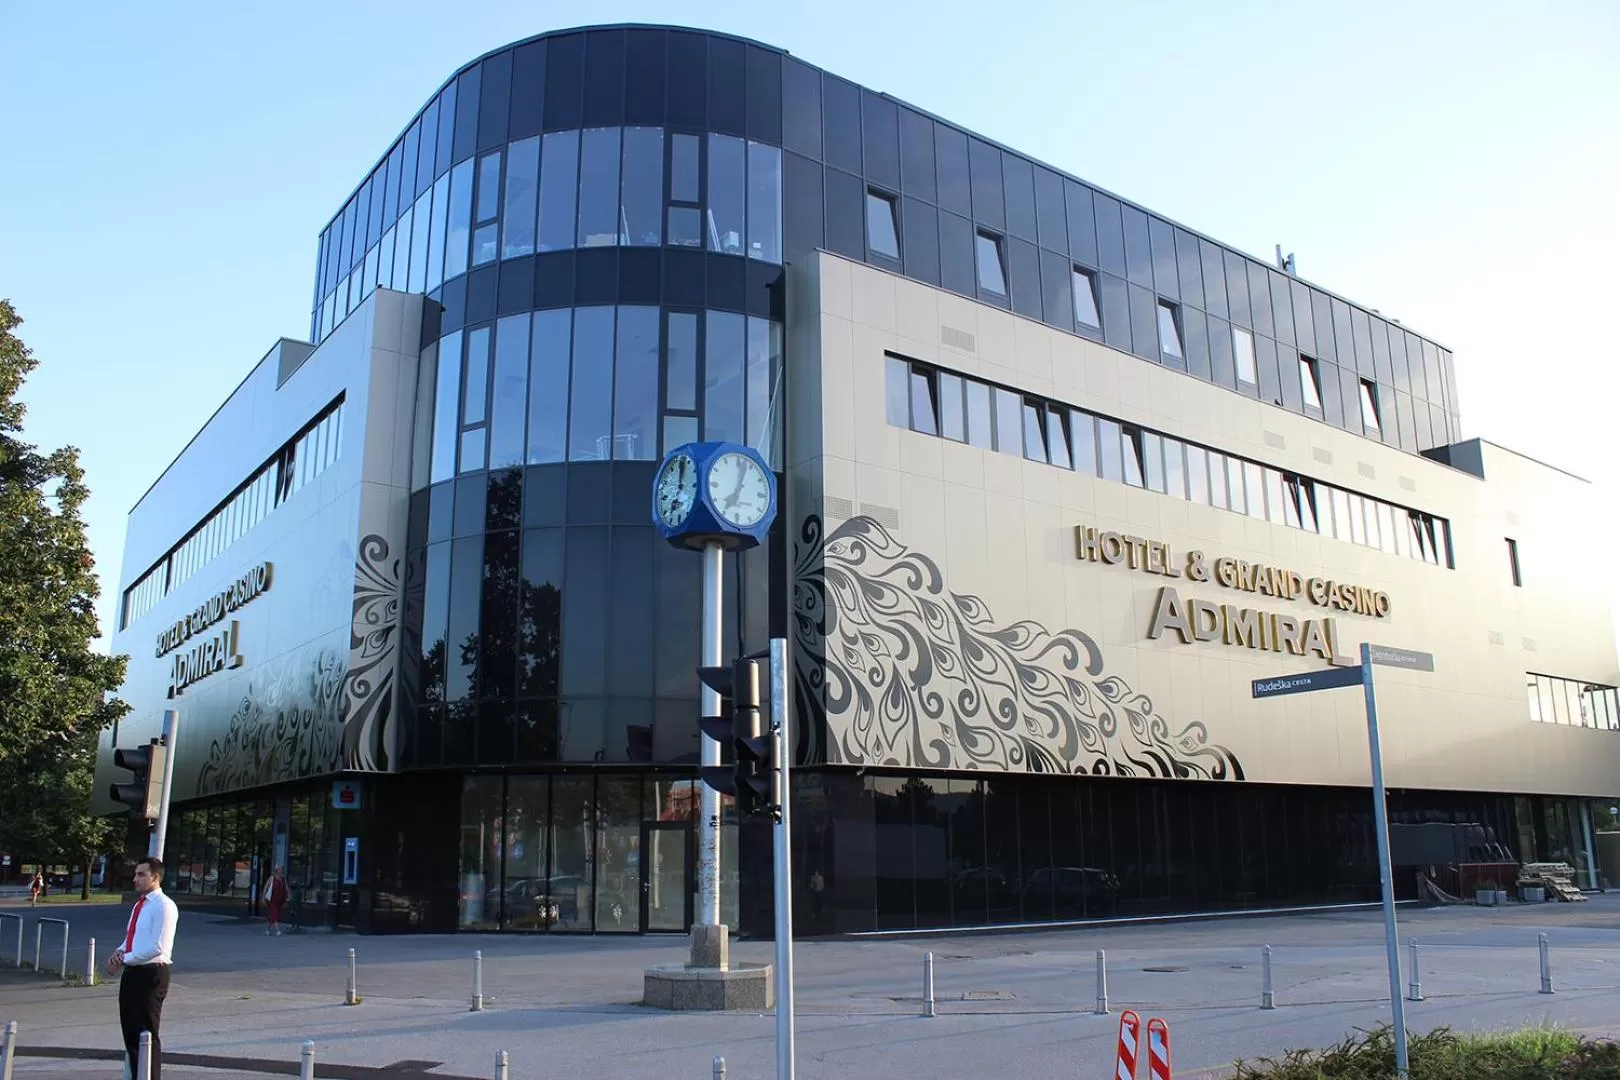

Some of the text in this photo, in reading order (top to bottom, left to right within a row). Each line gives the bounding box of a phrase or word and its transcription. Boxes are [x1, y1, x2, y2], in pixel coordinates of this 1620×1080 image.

[223, 561, 274, 613] CASINO
[1075, 524, 1392, 618] HOTEL & GRAND CASINO
[167, 620, 243, 699] ADMIRAL
[1148, 586, 1354, 667] ADMIRAL
[1257, 680, 1292, 692] Rudeška
